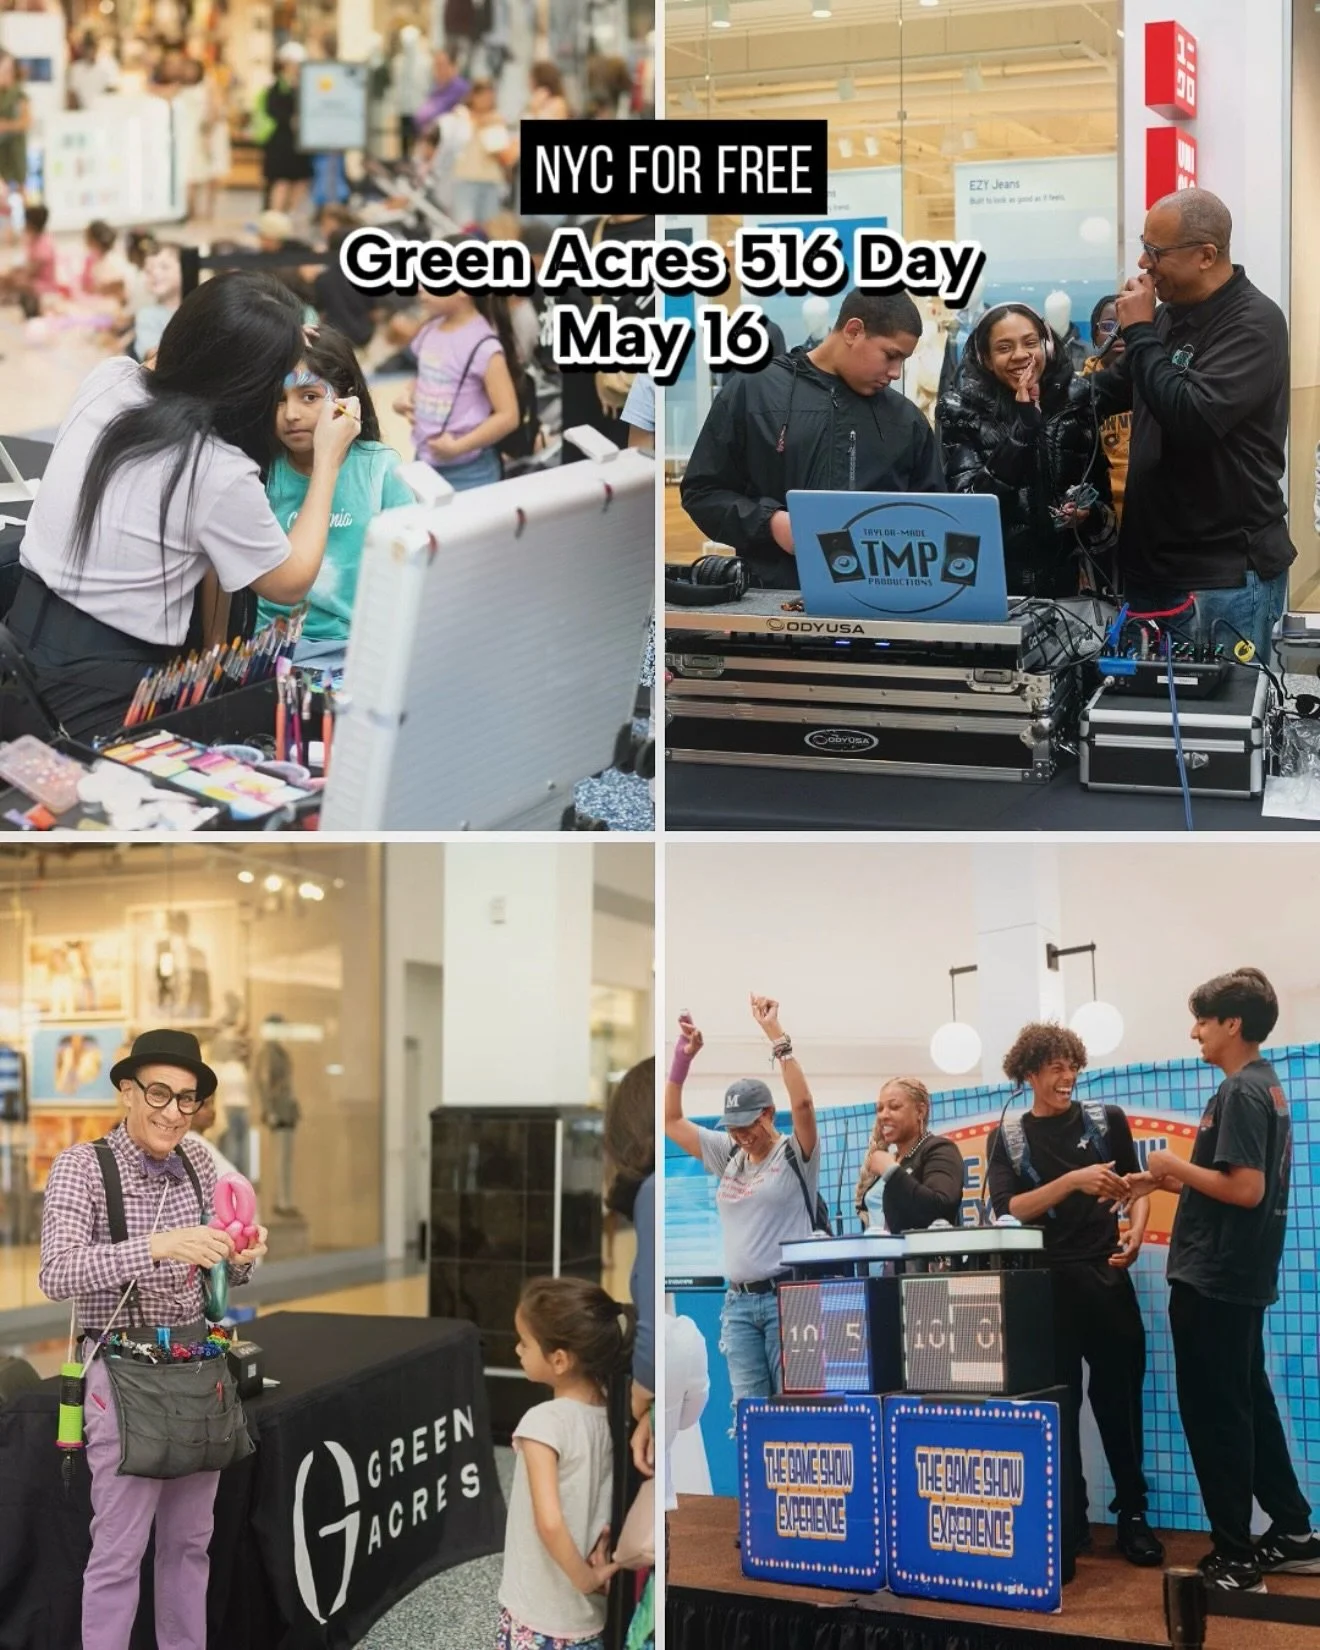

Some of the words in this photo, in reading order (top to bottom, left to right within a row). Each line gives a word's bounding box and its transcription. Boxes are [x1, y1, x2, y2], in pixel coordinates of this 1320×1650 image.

[1177, 138, 1195, 175] UNI
[969, 179, 989, 191] EZY
[992, 178, 1020, 190] Jeans
[863, 528, 926, 537] TAYLOR-MADE
[861, 540, 938, 577] TMP
[868, 577, 933, 587] PRODUCTIONS
[726, 1094, 739, 1108] M
[367, 1404, 475, 1489] GREEN
[765, 1446, 787, 1484] THE
[787, 1447, 819, 1486] GAME
[819, 1448, 852, 1488] SHOW
[918, 1452, 943, 1492] THE
[944, 1454, 981, 1496] GAME
[982, 1456, 1023, 1499] SHOW
[367, 1462, 481, 1556] ACRES
[778, 1494, 846, 1534] EXPERIENCE
[931, 1504, 1012, 1551] EXPERIENCE
